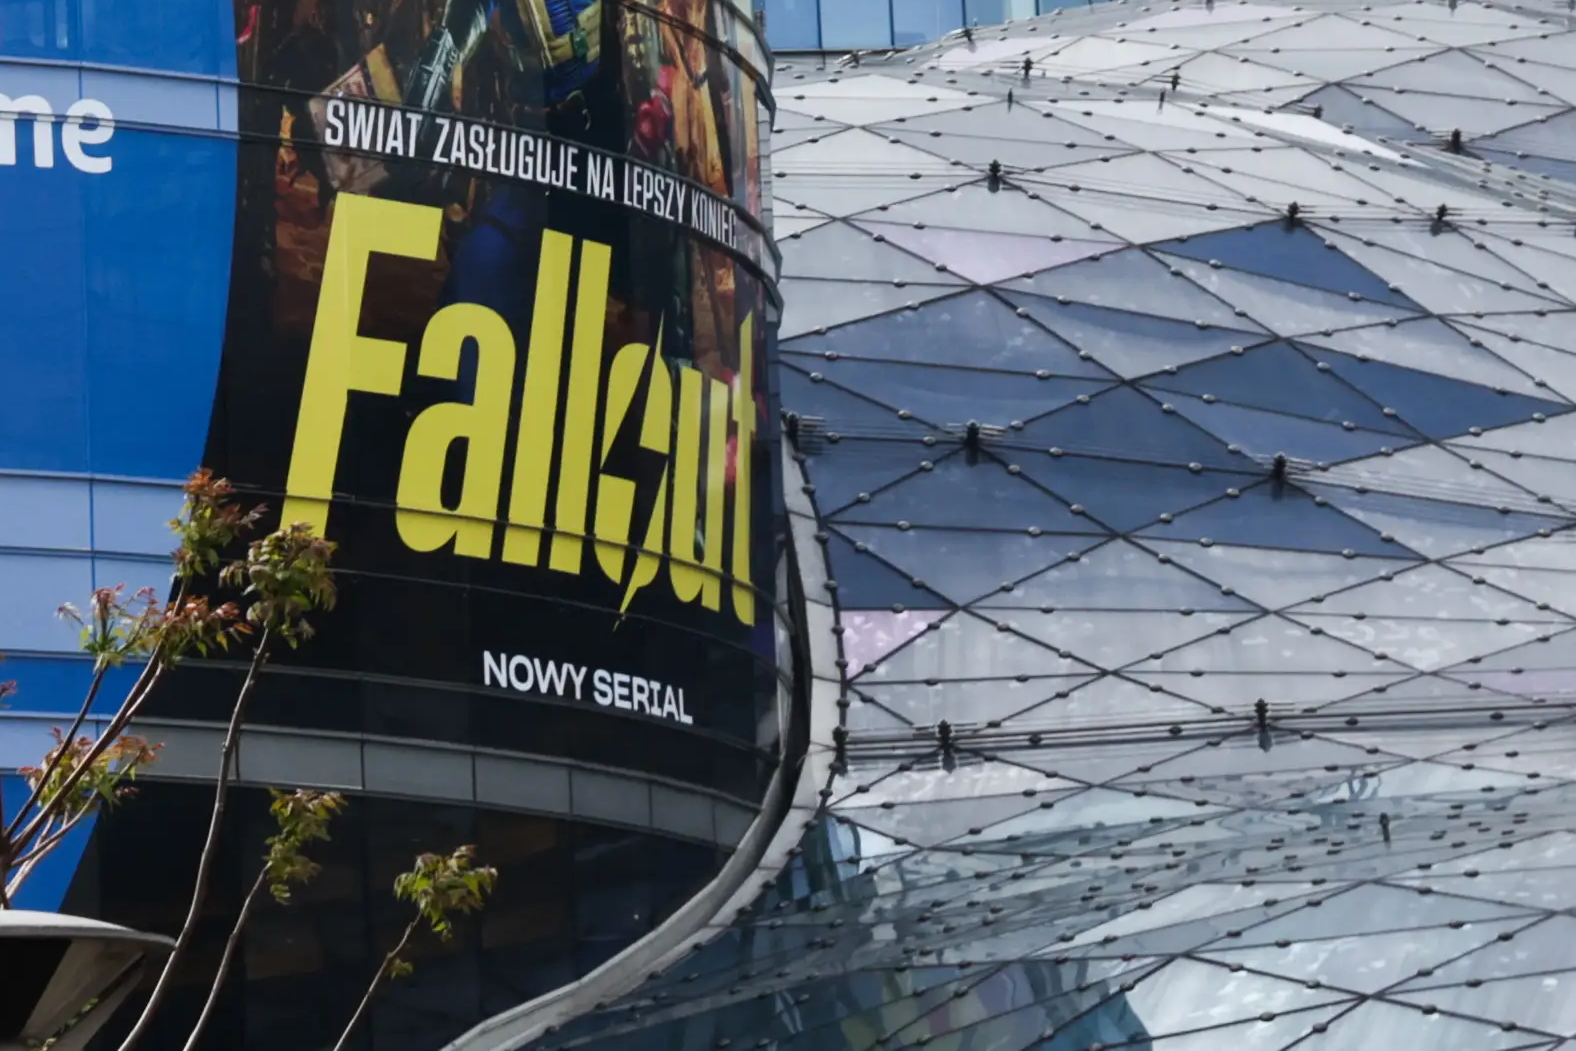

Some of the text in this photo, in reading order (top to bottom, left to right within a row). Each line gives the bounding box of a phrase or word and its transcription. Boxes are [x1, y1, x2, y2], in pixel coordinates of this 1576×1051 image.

[432, 117, 578, 191] ZASŁUGUJE
[586, 152, 614, 201] NA
[624, 161, 686, 224] LEPSZY
[691, 188, 737, 249] KONIEC
[279, 191, 756, 632] Fallout
[483, 650, 693, 724] NOWY SERIAL
